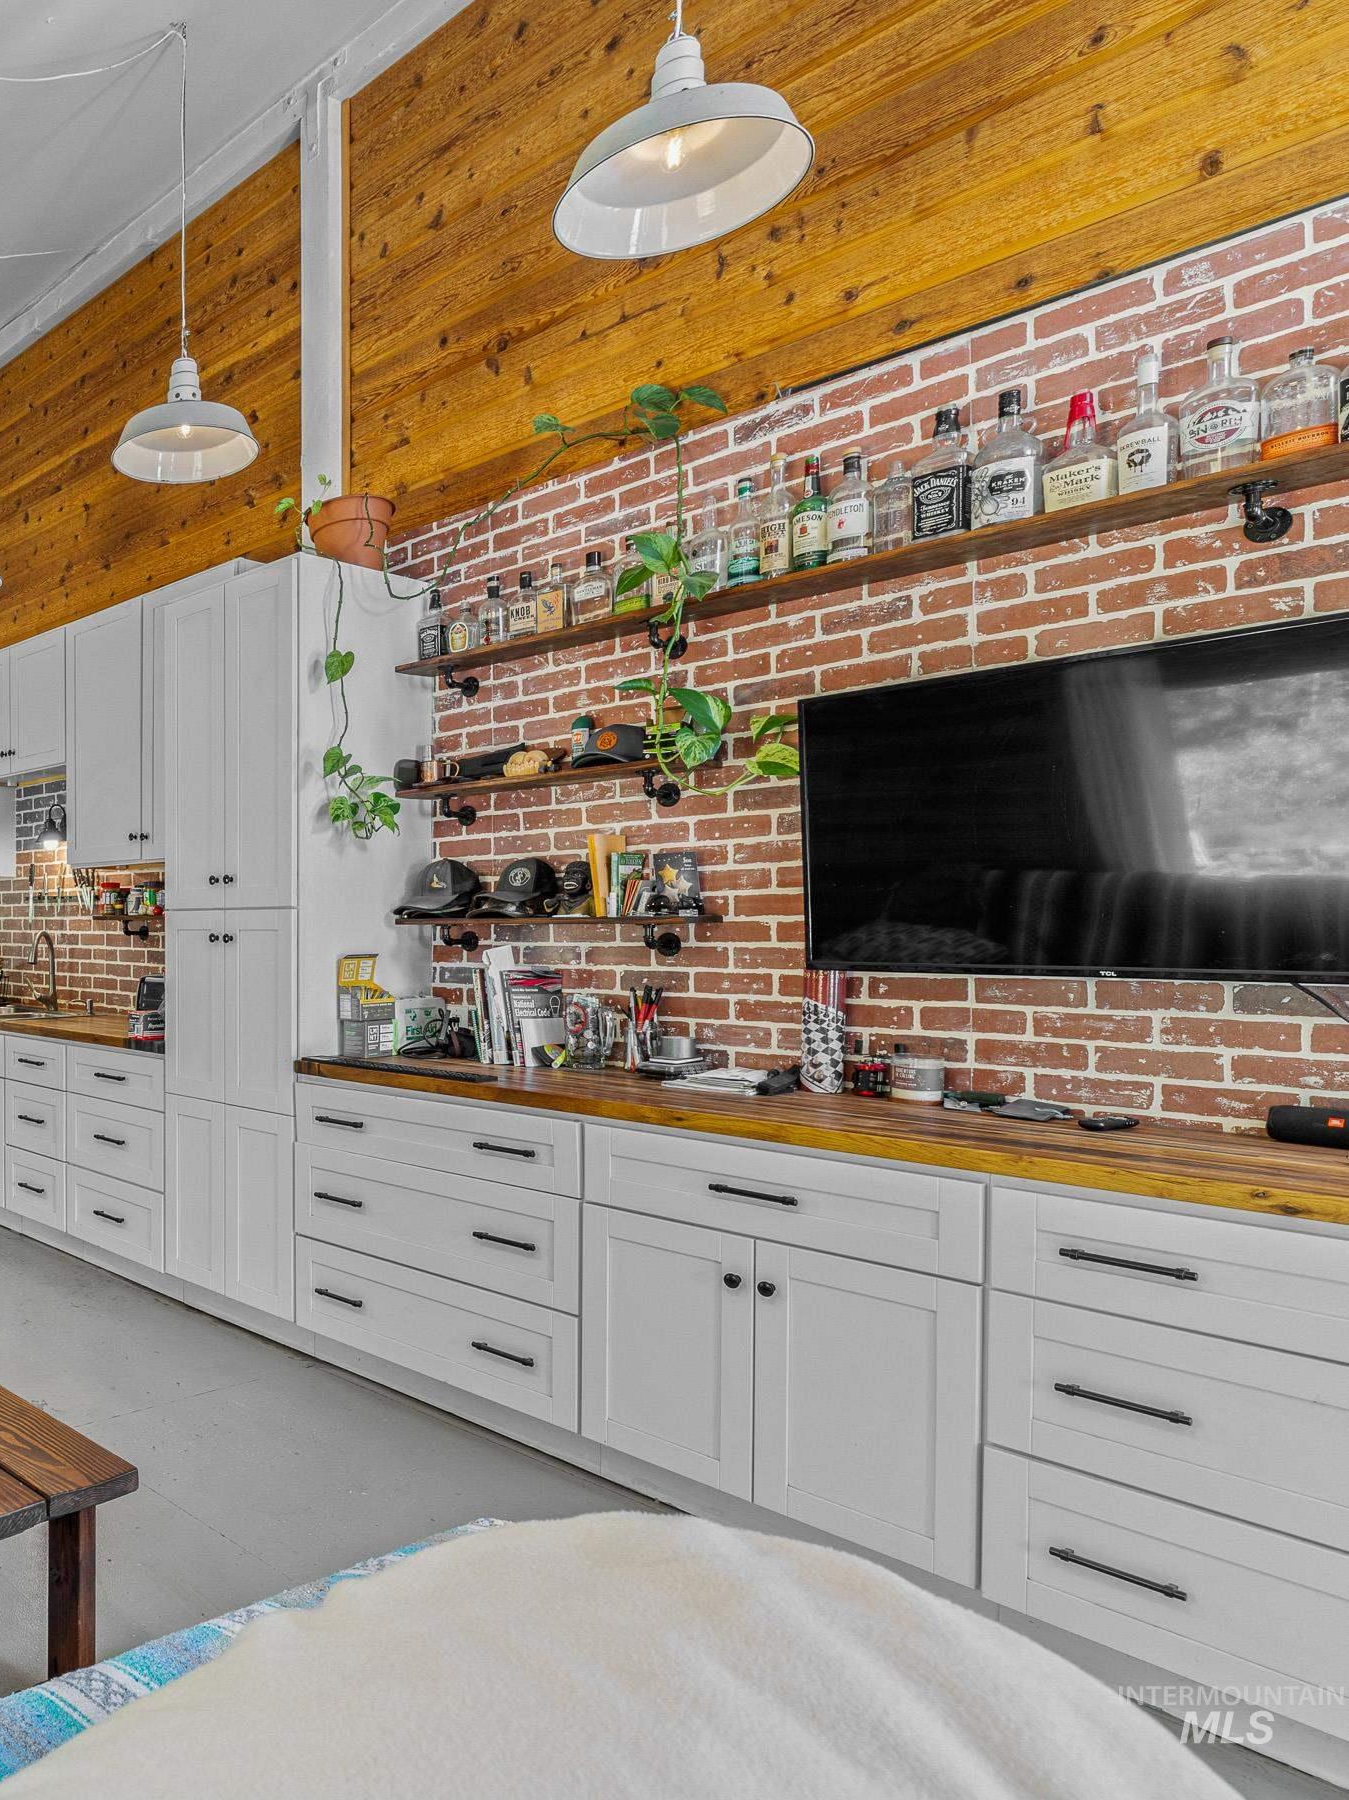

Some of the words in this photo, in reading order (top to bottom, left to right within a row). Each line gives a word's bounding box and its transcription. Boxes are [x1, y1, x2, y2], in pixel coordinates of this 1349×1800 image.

[1049, 465, 1101, 484] Maker's
[991, 476, 1026, 488] KRAKEN
[1063, 474, 1101, 489] Mark
[913, 481, 930, 498] JACK
[761, 522, 786, 534] HIGH
[510, 605, 531, 619] KNOB
[513, 999, 535, 1009] National
[514, 1008, 537, 1017] Electrical
[405, 1025, 423, 1036] First
